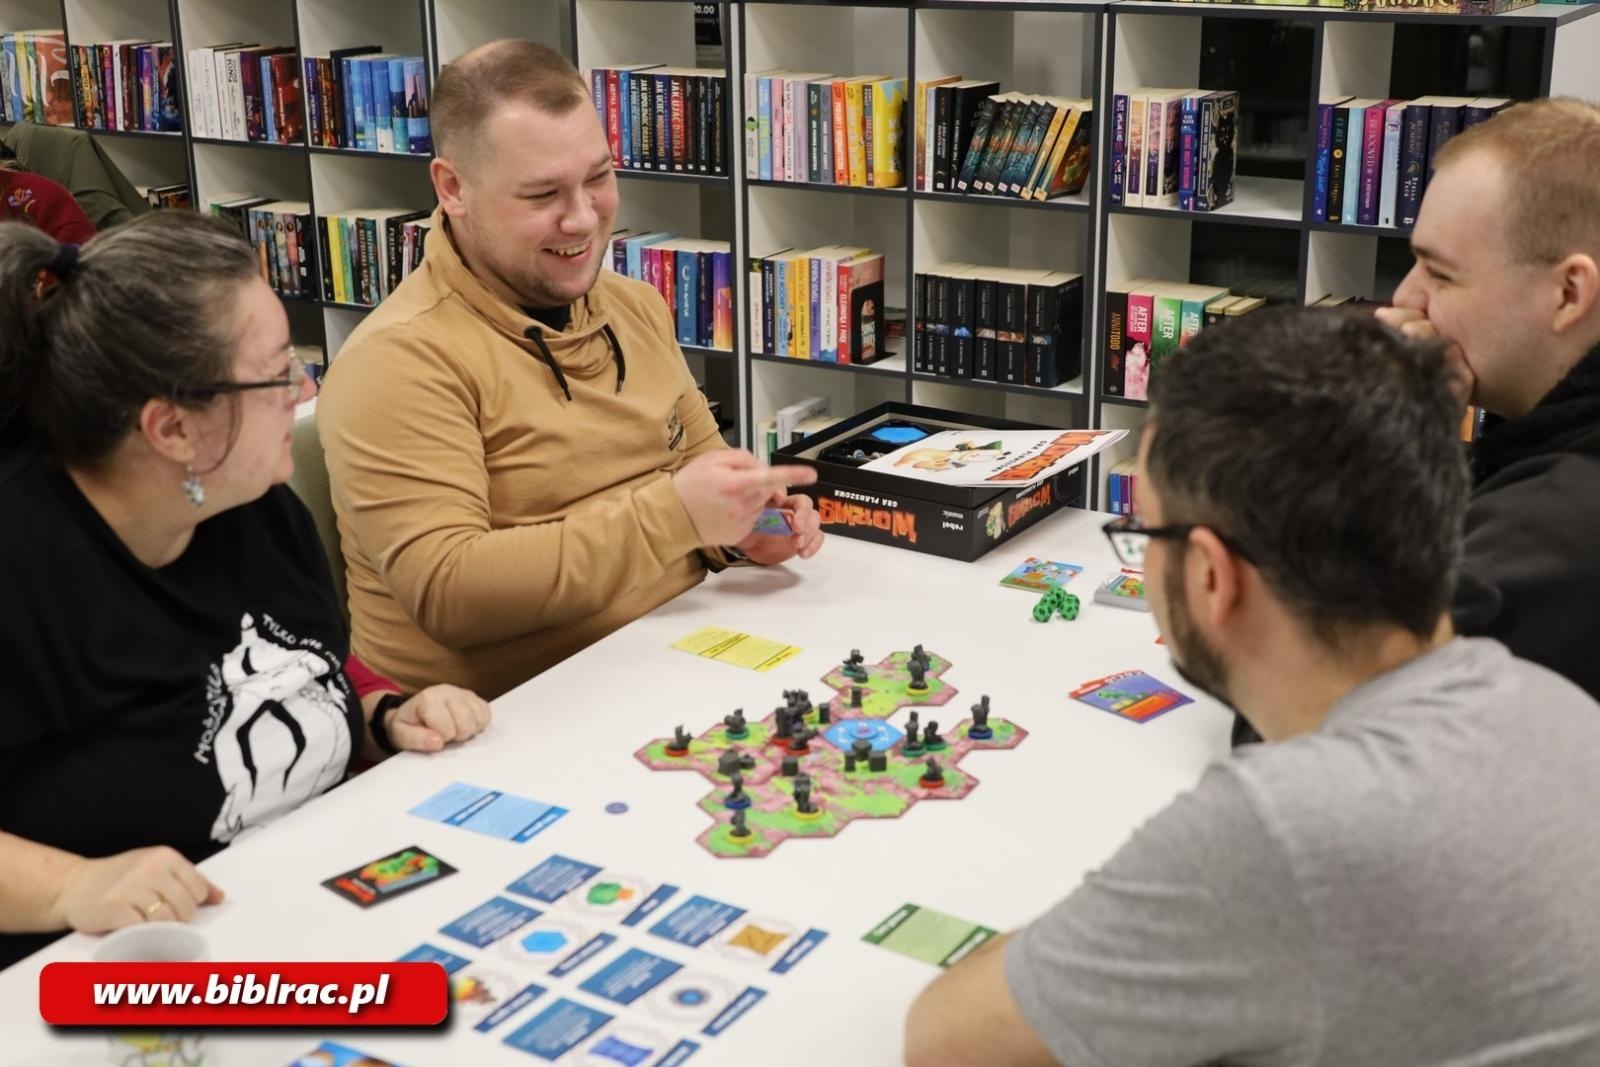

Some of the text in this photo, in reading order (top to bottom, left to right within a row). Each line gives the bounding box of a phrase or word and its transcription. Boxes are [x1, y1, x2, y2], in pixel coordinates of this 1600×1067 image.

[656, 80, 664, 94] JAK
[671, 80, 680, 98] JAK
[1410, 176, 1418, 202] STELLA
[1137, 306, 1148, 333] AFTER
[1162, 308, 1175, 339] AFTER
[834, 490, 898, 508] GRA PLANSZOWA
[818, 496, 916, 544] WORMS
[942, 522, 964, 531] rebel
